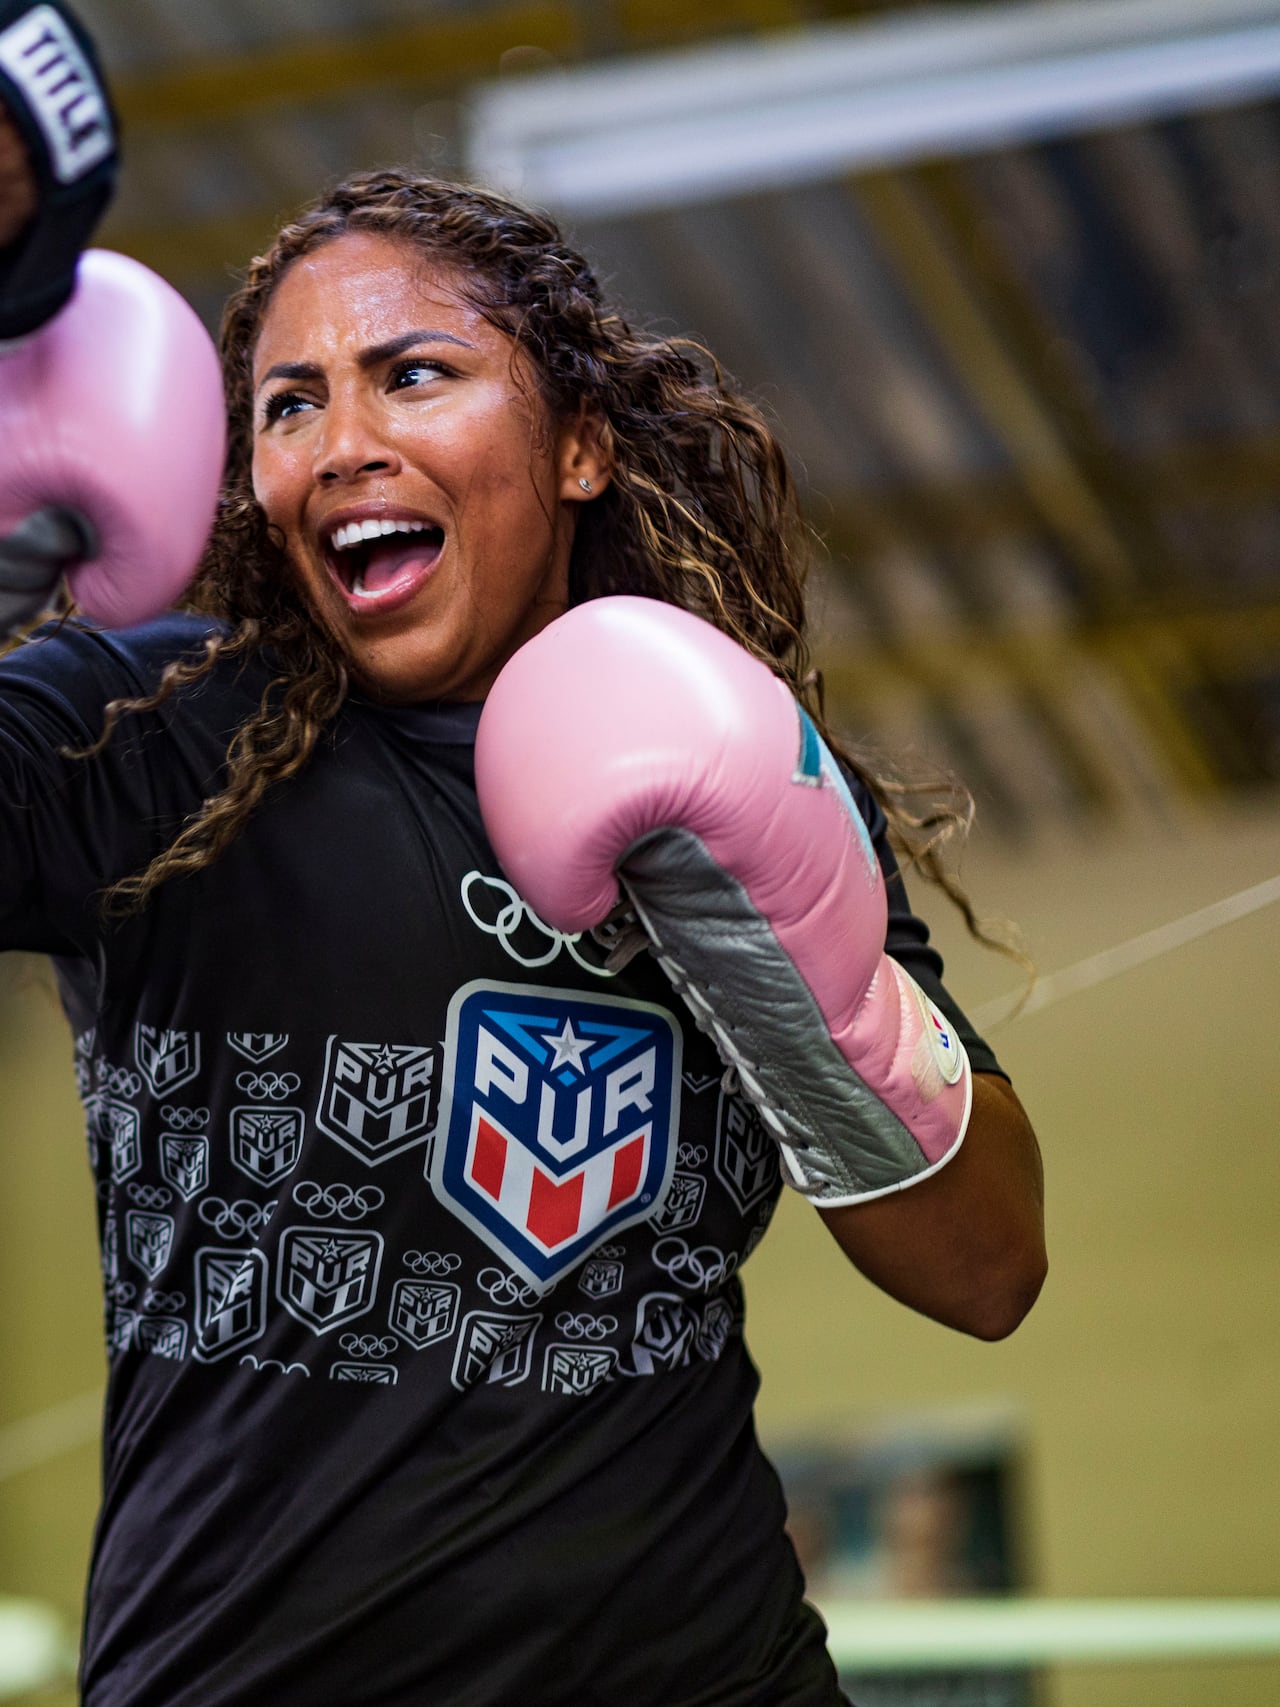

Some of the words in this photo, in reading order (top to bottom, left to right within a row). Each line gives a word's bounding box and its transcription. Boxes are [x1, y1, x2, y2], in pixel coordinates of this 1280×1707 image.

[22, 27, 100, 152] TITLE
[335, 1057, 434, 1108] PUR
[474, 1023, 657, 1163] PUR
[239, 1118, 296, 1152] PUR
[166, 1144, 205, 1171] PUR
[132, 1219, 170, 1249] PUR
[292, 1248, 370, 1290] PUR
[399, 1289, 453, 1320] PUR
[552, 1355, 613, 1389] PUR
